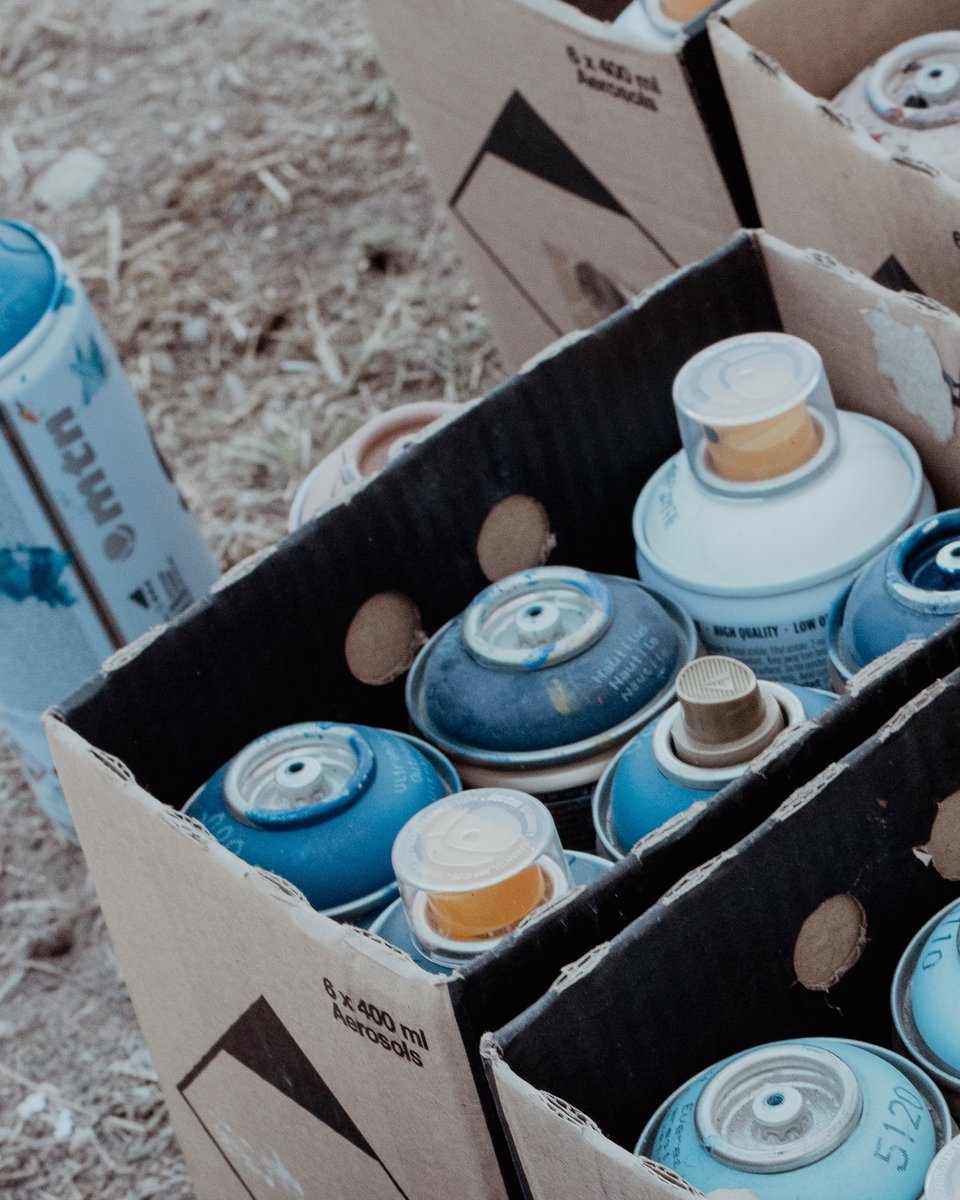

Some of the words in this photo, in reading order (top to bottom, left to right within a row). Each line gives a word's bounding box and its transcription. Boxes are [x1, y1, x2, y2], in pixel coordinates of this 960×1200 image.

[566, 45, 582, 65] 6
[598, 56, 634, 84] 400
[577, 68, 659, 112] Aerosols
[45, 406, 124, 528] mtn
[738, 625, 779, 641] QUALITY
[793, 618, 816, 635] LOW
[322, 977, 338, 1001] 6
[340, 991, 355, 1012] x
[356, 997, 397, 1034] 400
[399, 1019, 431, 1052] ml
[332, 1001, 426, 1068] Aerosols
[873, 1085, 928, 1172] 5120
